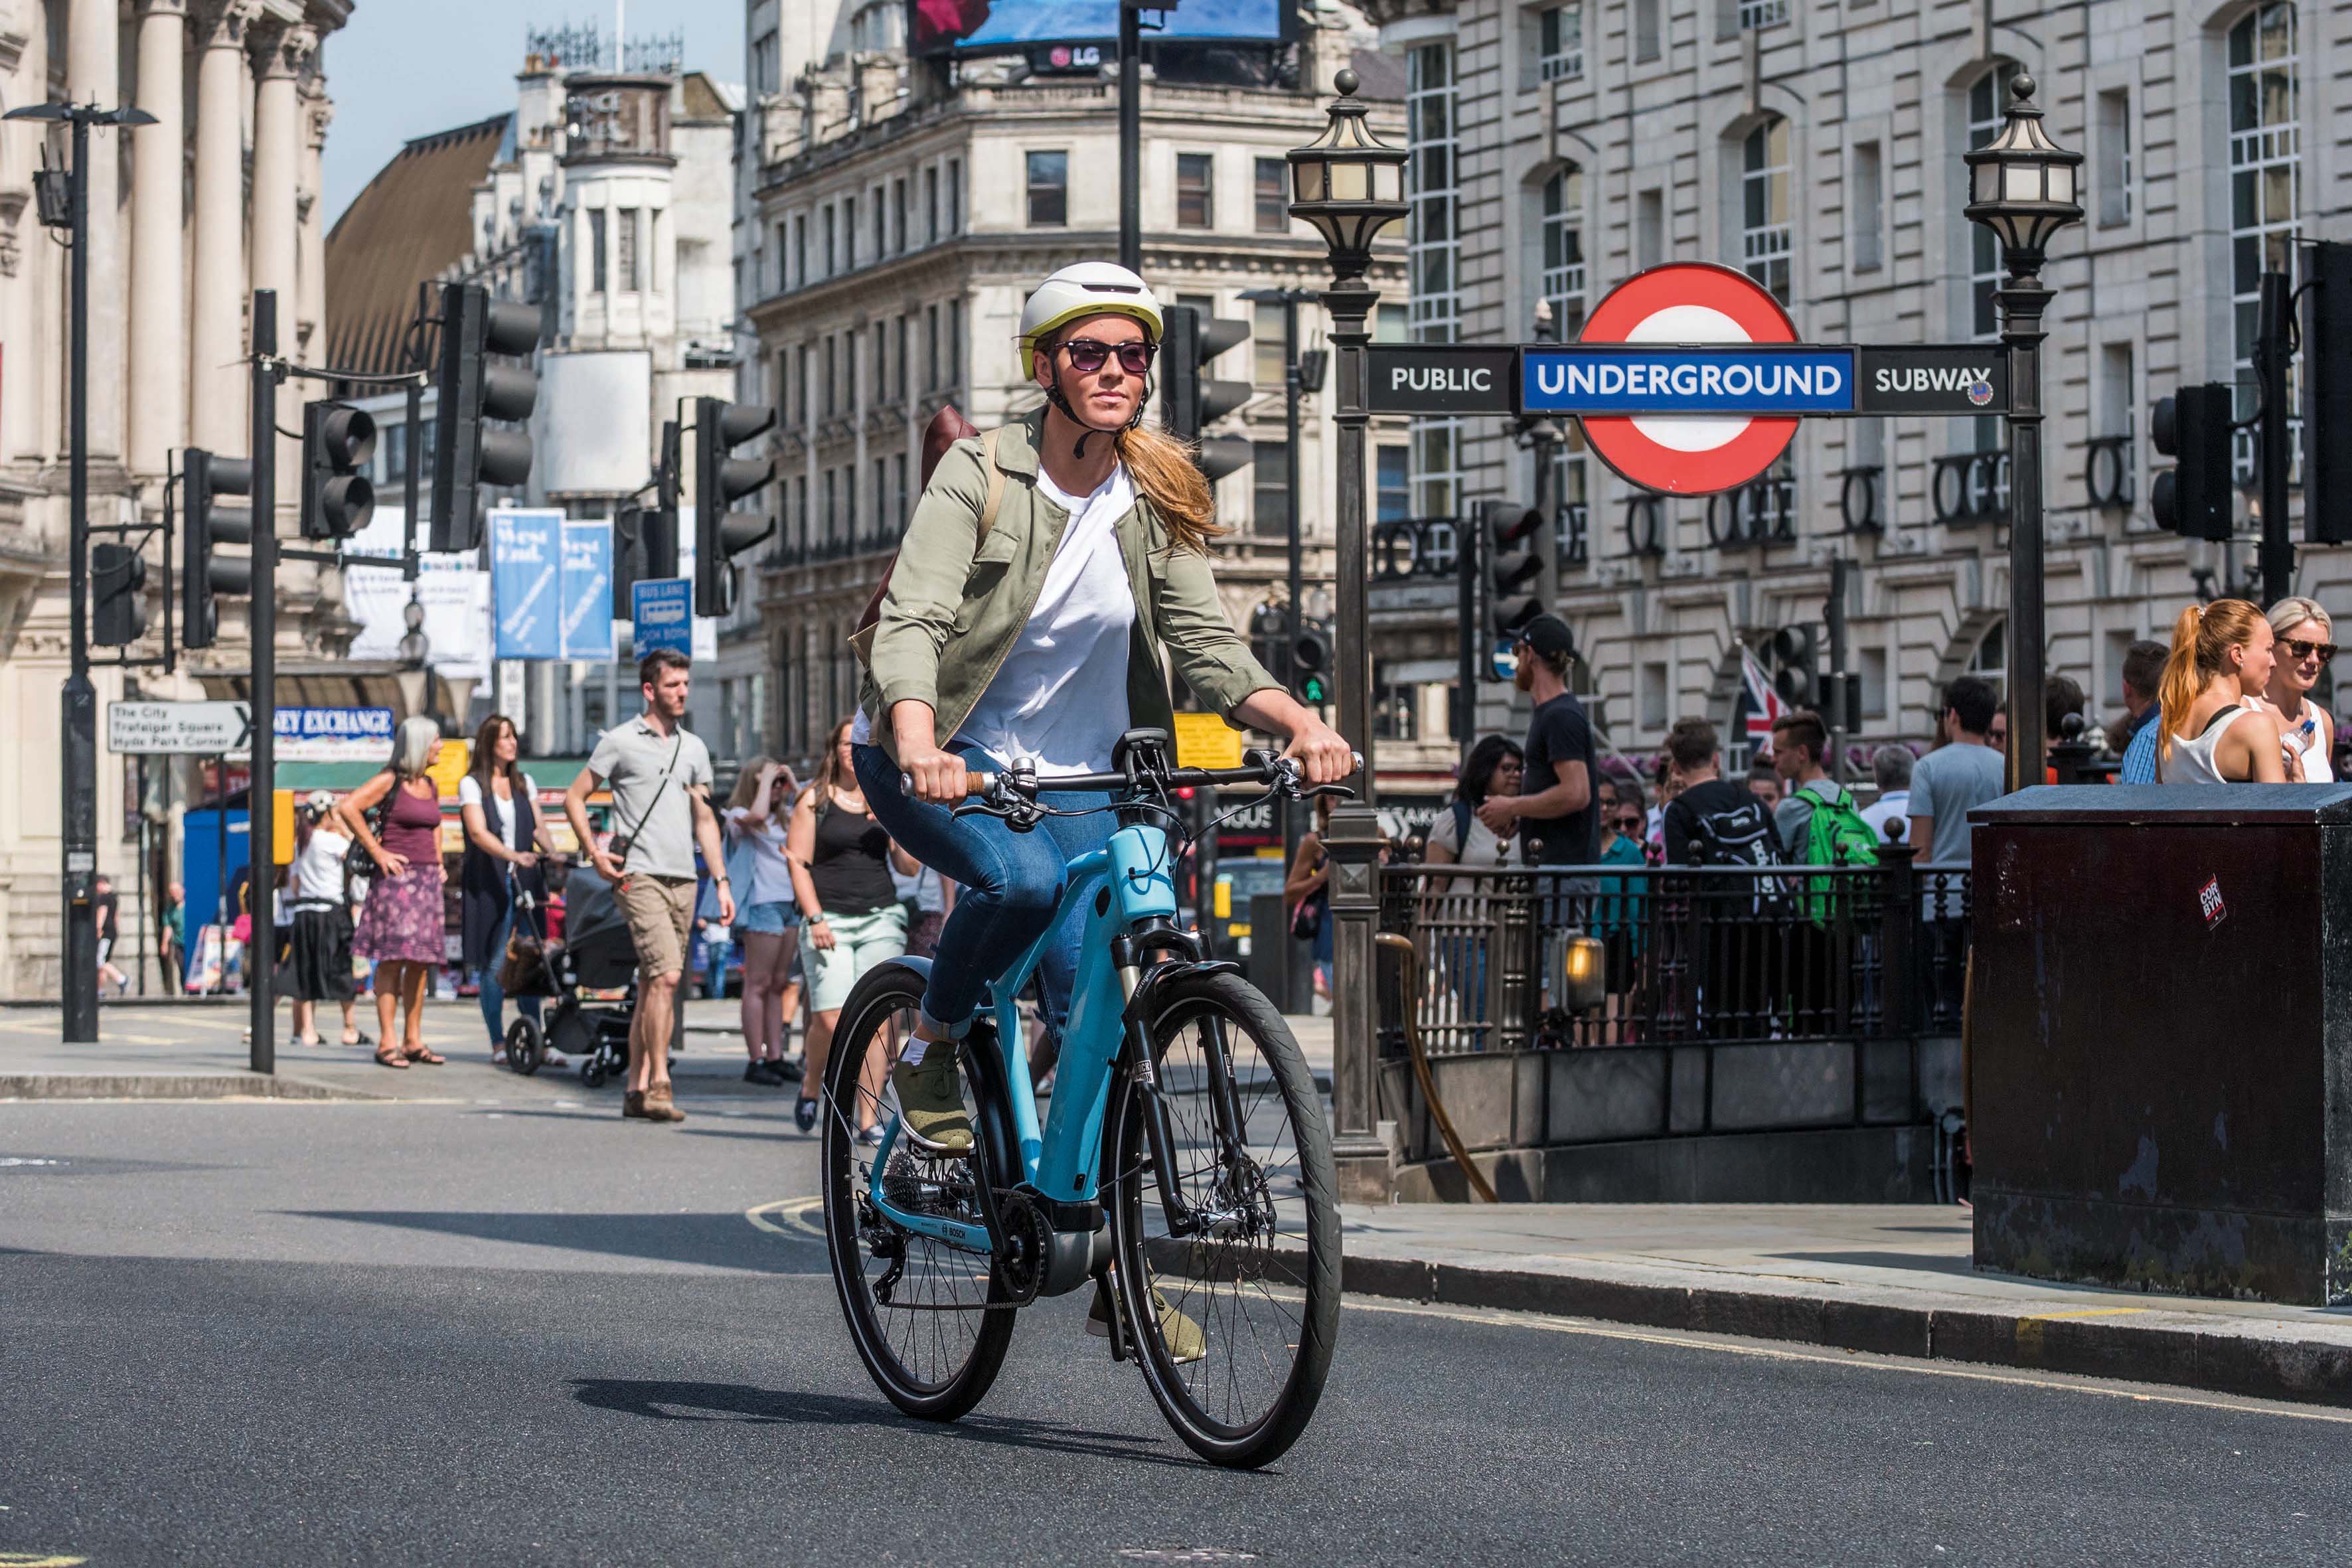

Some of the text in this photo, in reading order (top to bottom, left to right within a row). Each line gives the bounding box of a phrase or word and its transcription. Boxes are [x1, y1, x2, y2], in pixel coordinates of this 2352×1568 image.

[1073, 46, 1100, 66] LG
[1391, 367, 1492, 392] PUBLIC
[1537, 364, 1842, 396] UNDERGROUND
[1875, 367, 1992, 392] SUBWAY
[114, 707, 168, 718] The City
[303, 710, 392, 734] EXCHANGE
[114, 722, 224, 734] Trafalgar Square
[114, 736, 228, 749] Hyde Park Corner
[1214, 804, 1272, 829] NGUS
[2200, 882, 2218, 904] COR
[2203, 892, 2222, 917] BYN
[1135, 967, 1154, 998] paragon
[949, 1227, 966, 1240] BOSCH
